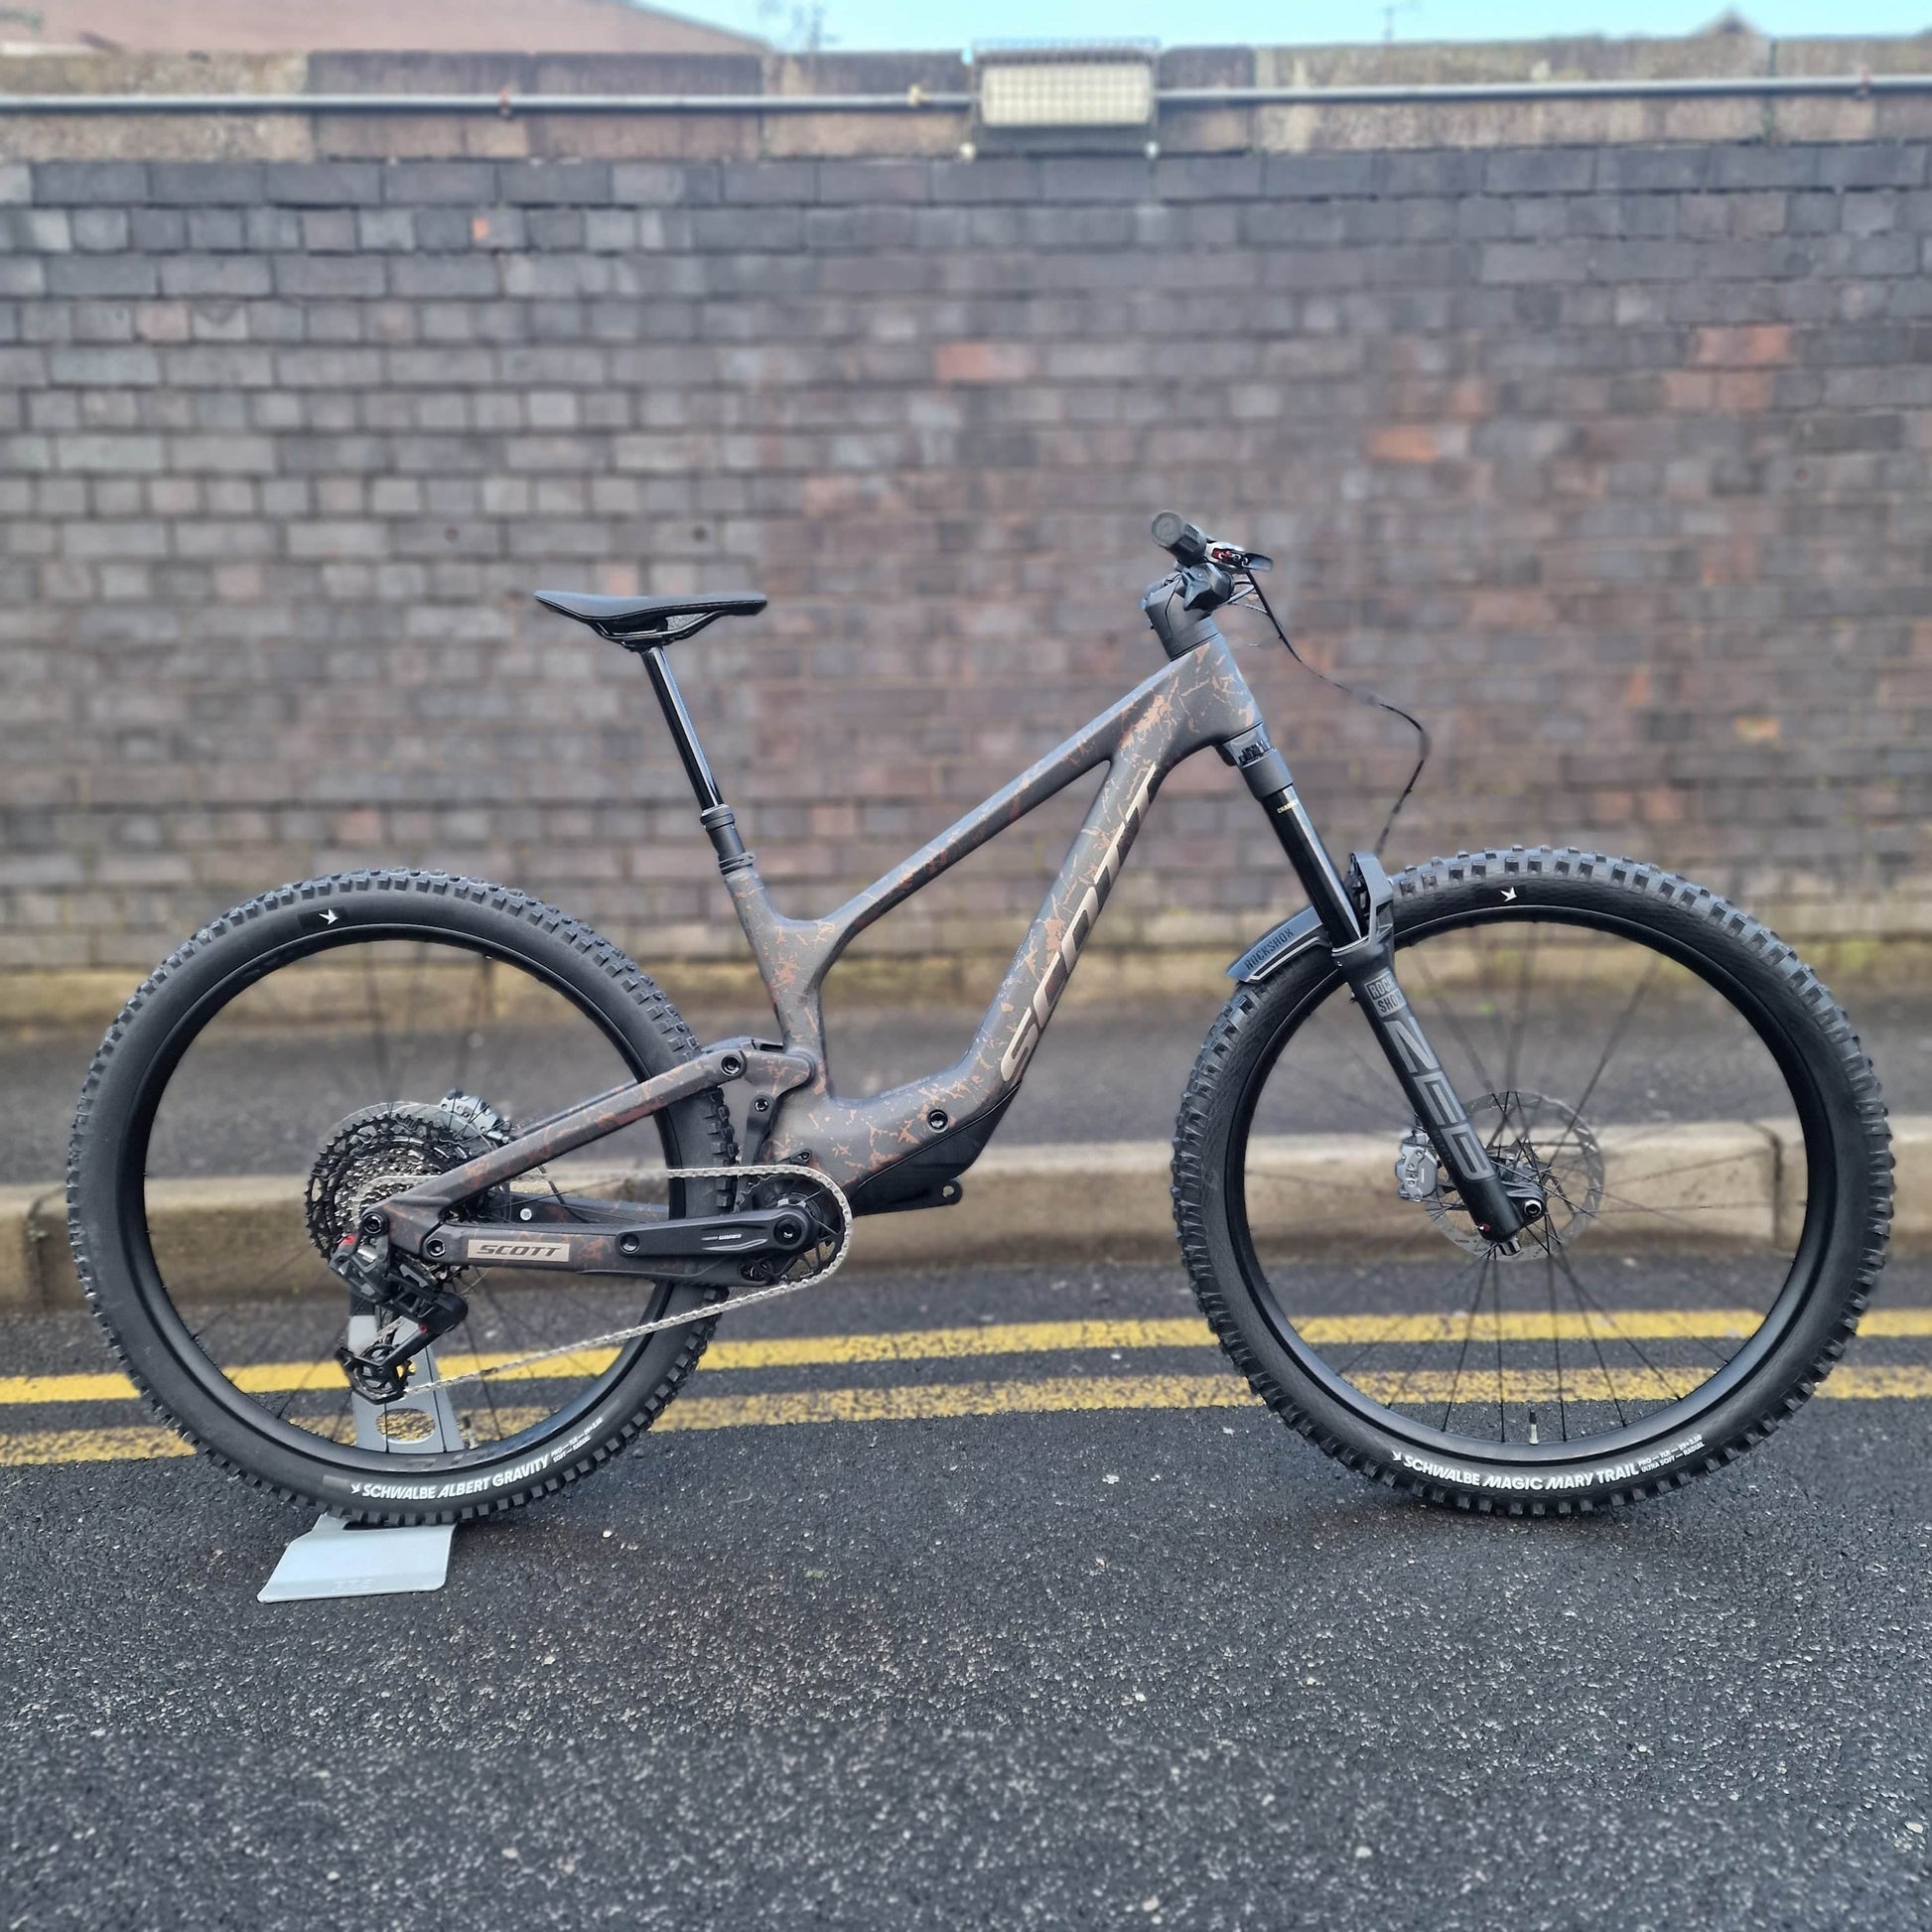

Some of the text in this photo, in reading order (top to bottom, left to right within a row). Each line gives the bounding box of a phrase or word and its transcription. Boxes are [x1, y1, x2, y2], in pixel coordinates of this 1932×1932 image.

[1244, 927, 1294, 970] ROCKSHOX
[1368, 974, 1396, 999] ROCK
[1384, 1017, 1495, 1180] ZEB
[477, 1244, 561, 1257] SCOTT
[1403, 1455, 1640, 1490] SCHWALBE MAGIC MARY TRAIL
[1641, 1442, 1706, 1472] ULTRA SOFT RADIAL
[361, 1453, 550, 1500] SCHWALBE ALBERT GRAVITY
